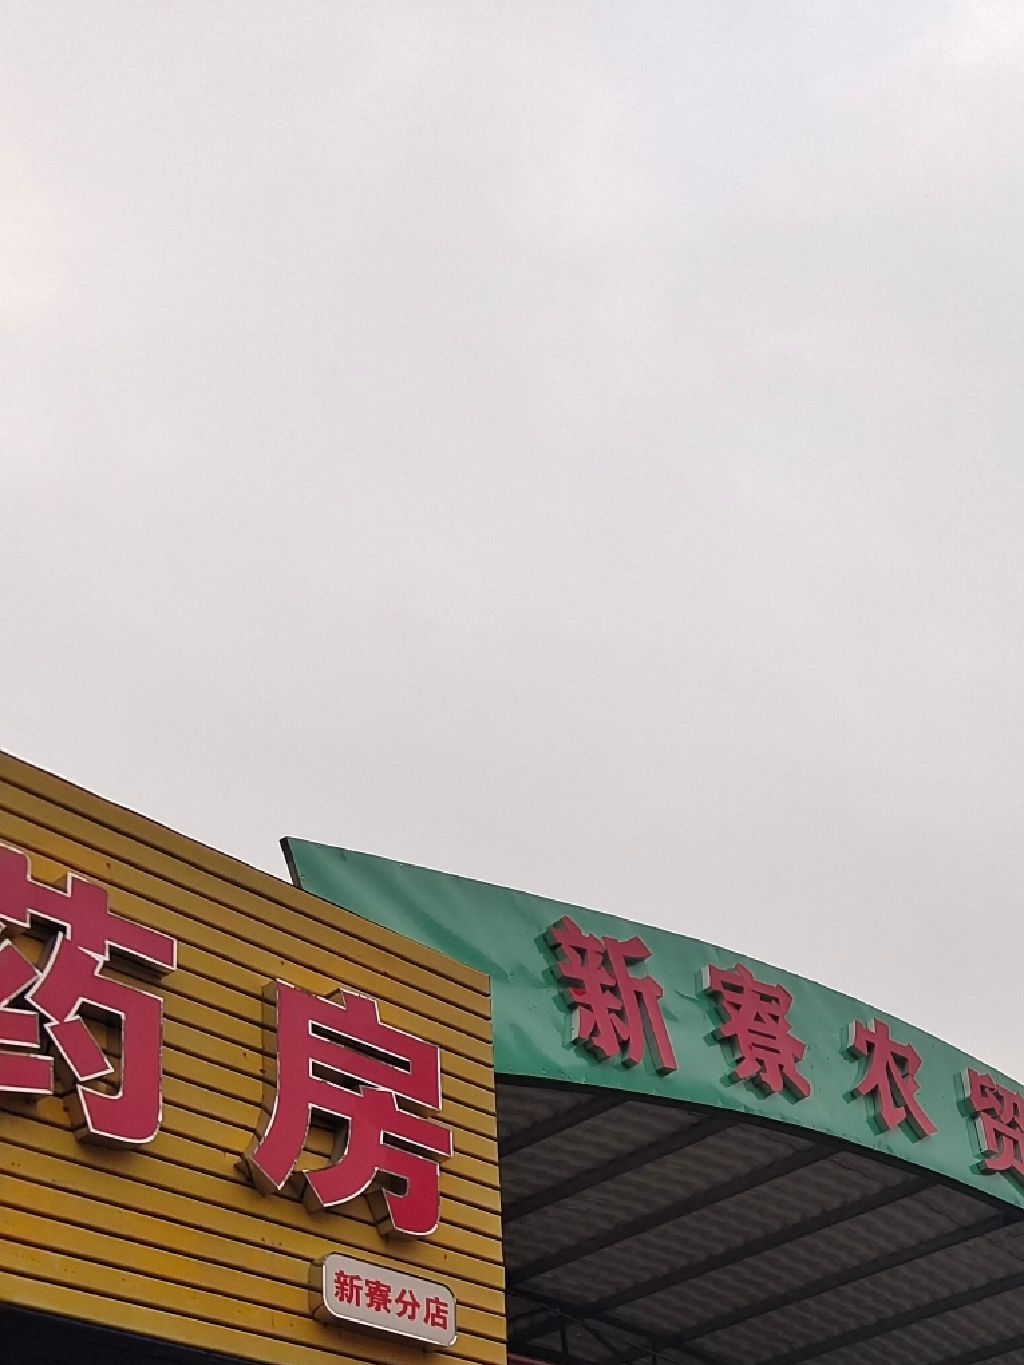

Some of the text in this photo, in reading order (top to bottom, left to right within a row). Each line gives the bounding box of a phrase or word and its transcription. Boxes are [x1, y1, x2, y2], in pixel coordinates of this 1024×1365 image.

[0, 843, 454, 1234] 药房
[335, 1270, 449, 1329] 新寮分店
